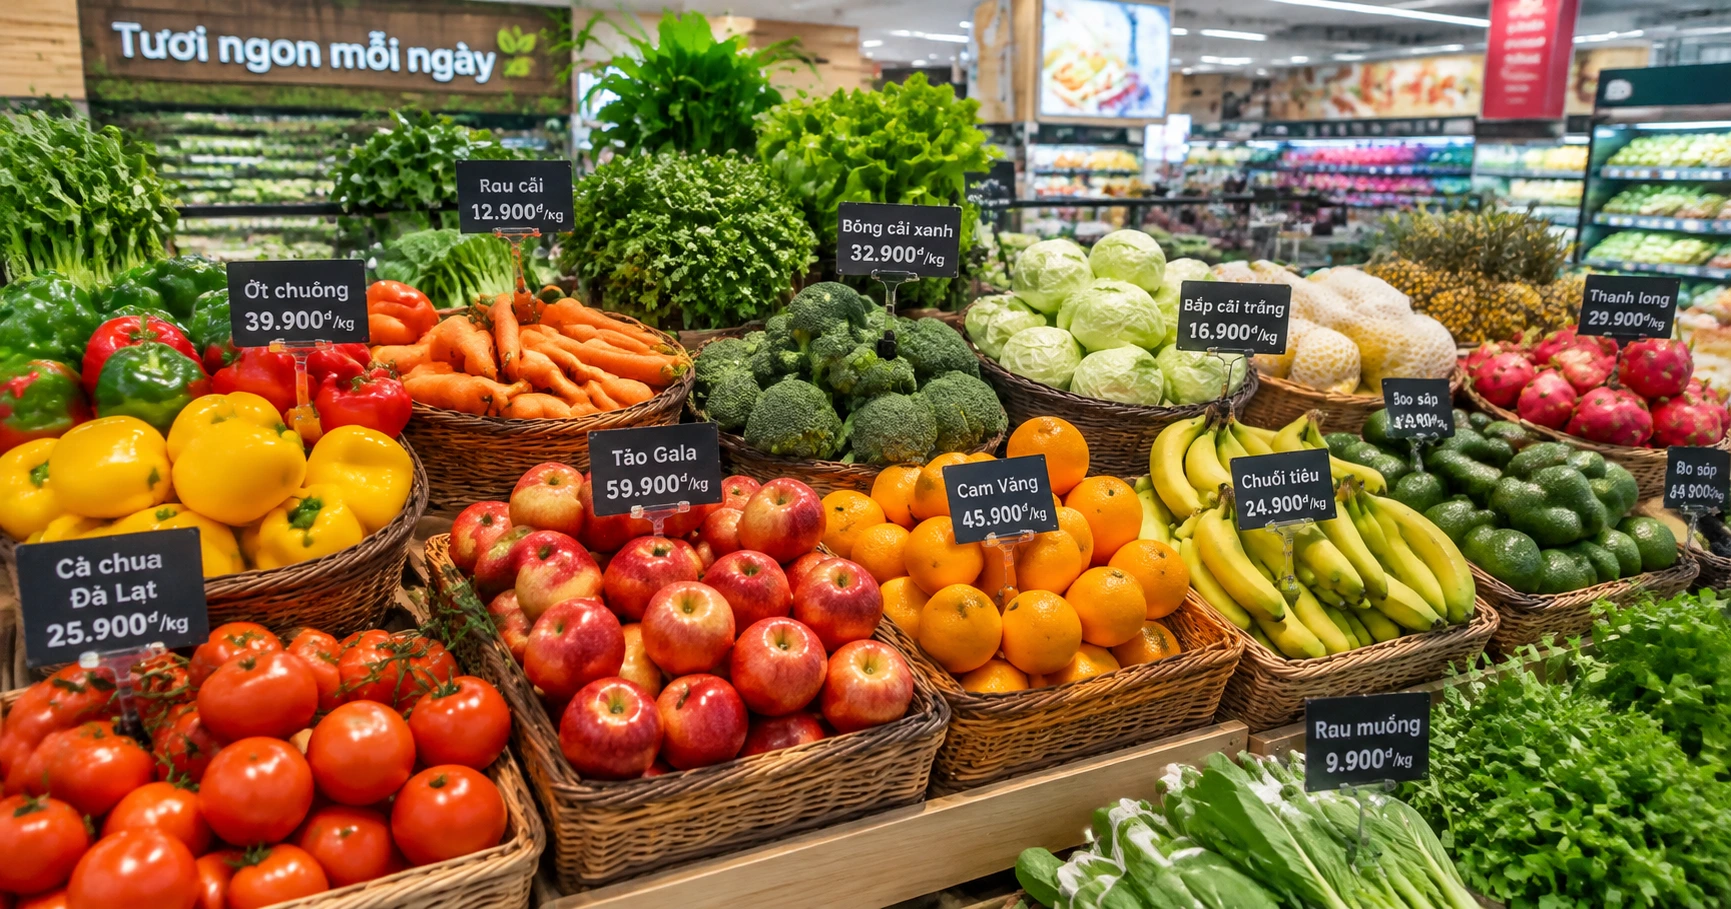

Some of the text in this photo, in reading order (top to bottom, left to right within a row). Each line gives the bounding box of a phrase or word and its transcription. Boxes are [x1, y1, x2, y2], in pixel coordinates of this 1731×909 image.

[112, 22, 496, 83] Tươi ngon mỗi ngày
[480, 179, 513, 192] Rau
[914, 224, 952, 237] xanh
[275, 281, 348, 301] chuông
[1590, 289, 1670, 308] Thanh long
[654, 444, 696, 463] Gala
[1290, 468, 1318, 484] tiêu
[958, 484, 993, 498] Cam
[99, 553, 162, 574] chua
[116, 581, 157, 604] Lạt
[1316, 714, 1420, 739] Rau muống
